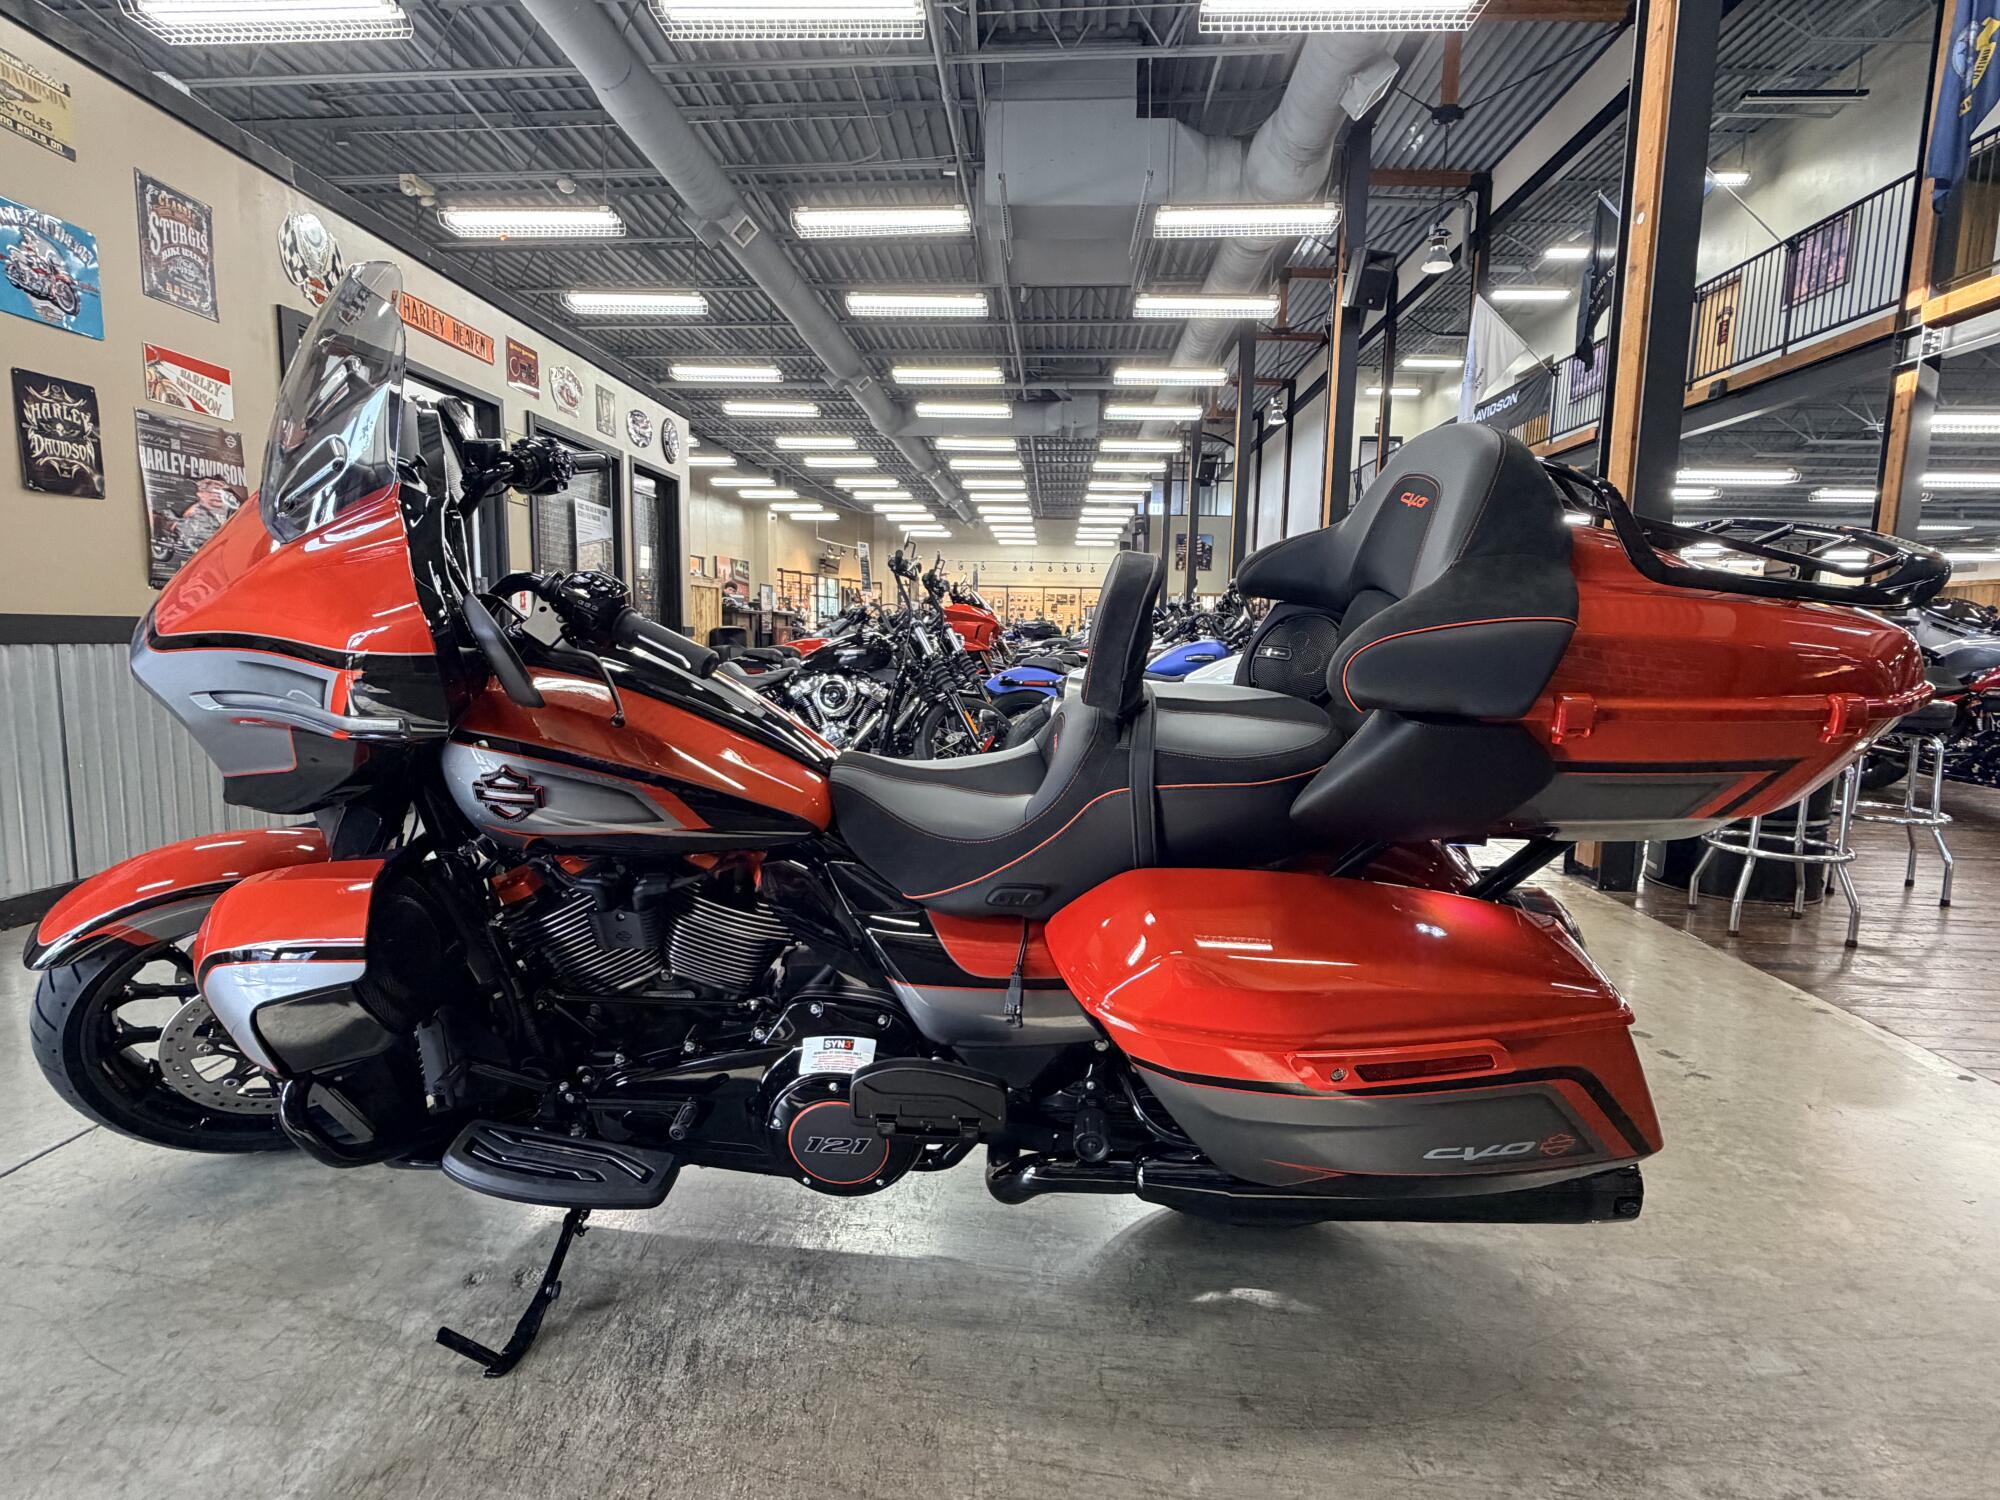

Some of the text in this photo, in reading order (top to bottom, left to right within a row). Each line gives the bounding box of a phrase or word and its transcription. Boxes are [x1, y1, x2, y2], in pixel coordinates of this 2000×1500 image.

[149, 210, 209, 256] STURGIS
[402, 295, 445, 337] HARLEY
[452, 321, 487, 358] HEAVEN
[176, 376, 222, 416] DAVIDSON
[180, 369, 226, 397] HARLEY-
[25, 400, 92, 432] HARLEY
[30, 433, 95, 466] DAVIDSON
[139, 445, 247, 487] HARLEY-DAVIDSON
[824, 1039, 853, 1049] SYN3
[804, 1136, 872, 1155] 121
[1423, 1141, 1536, 1161] CVO
